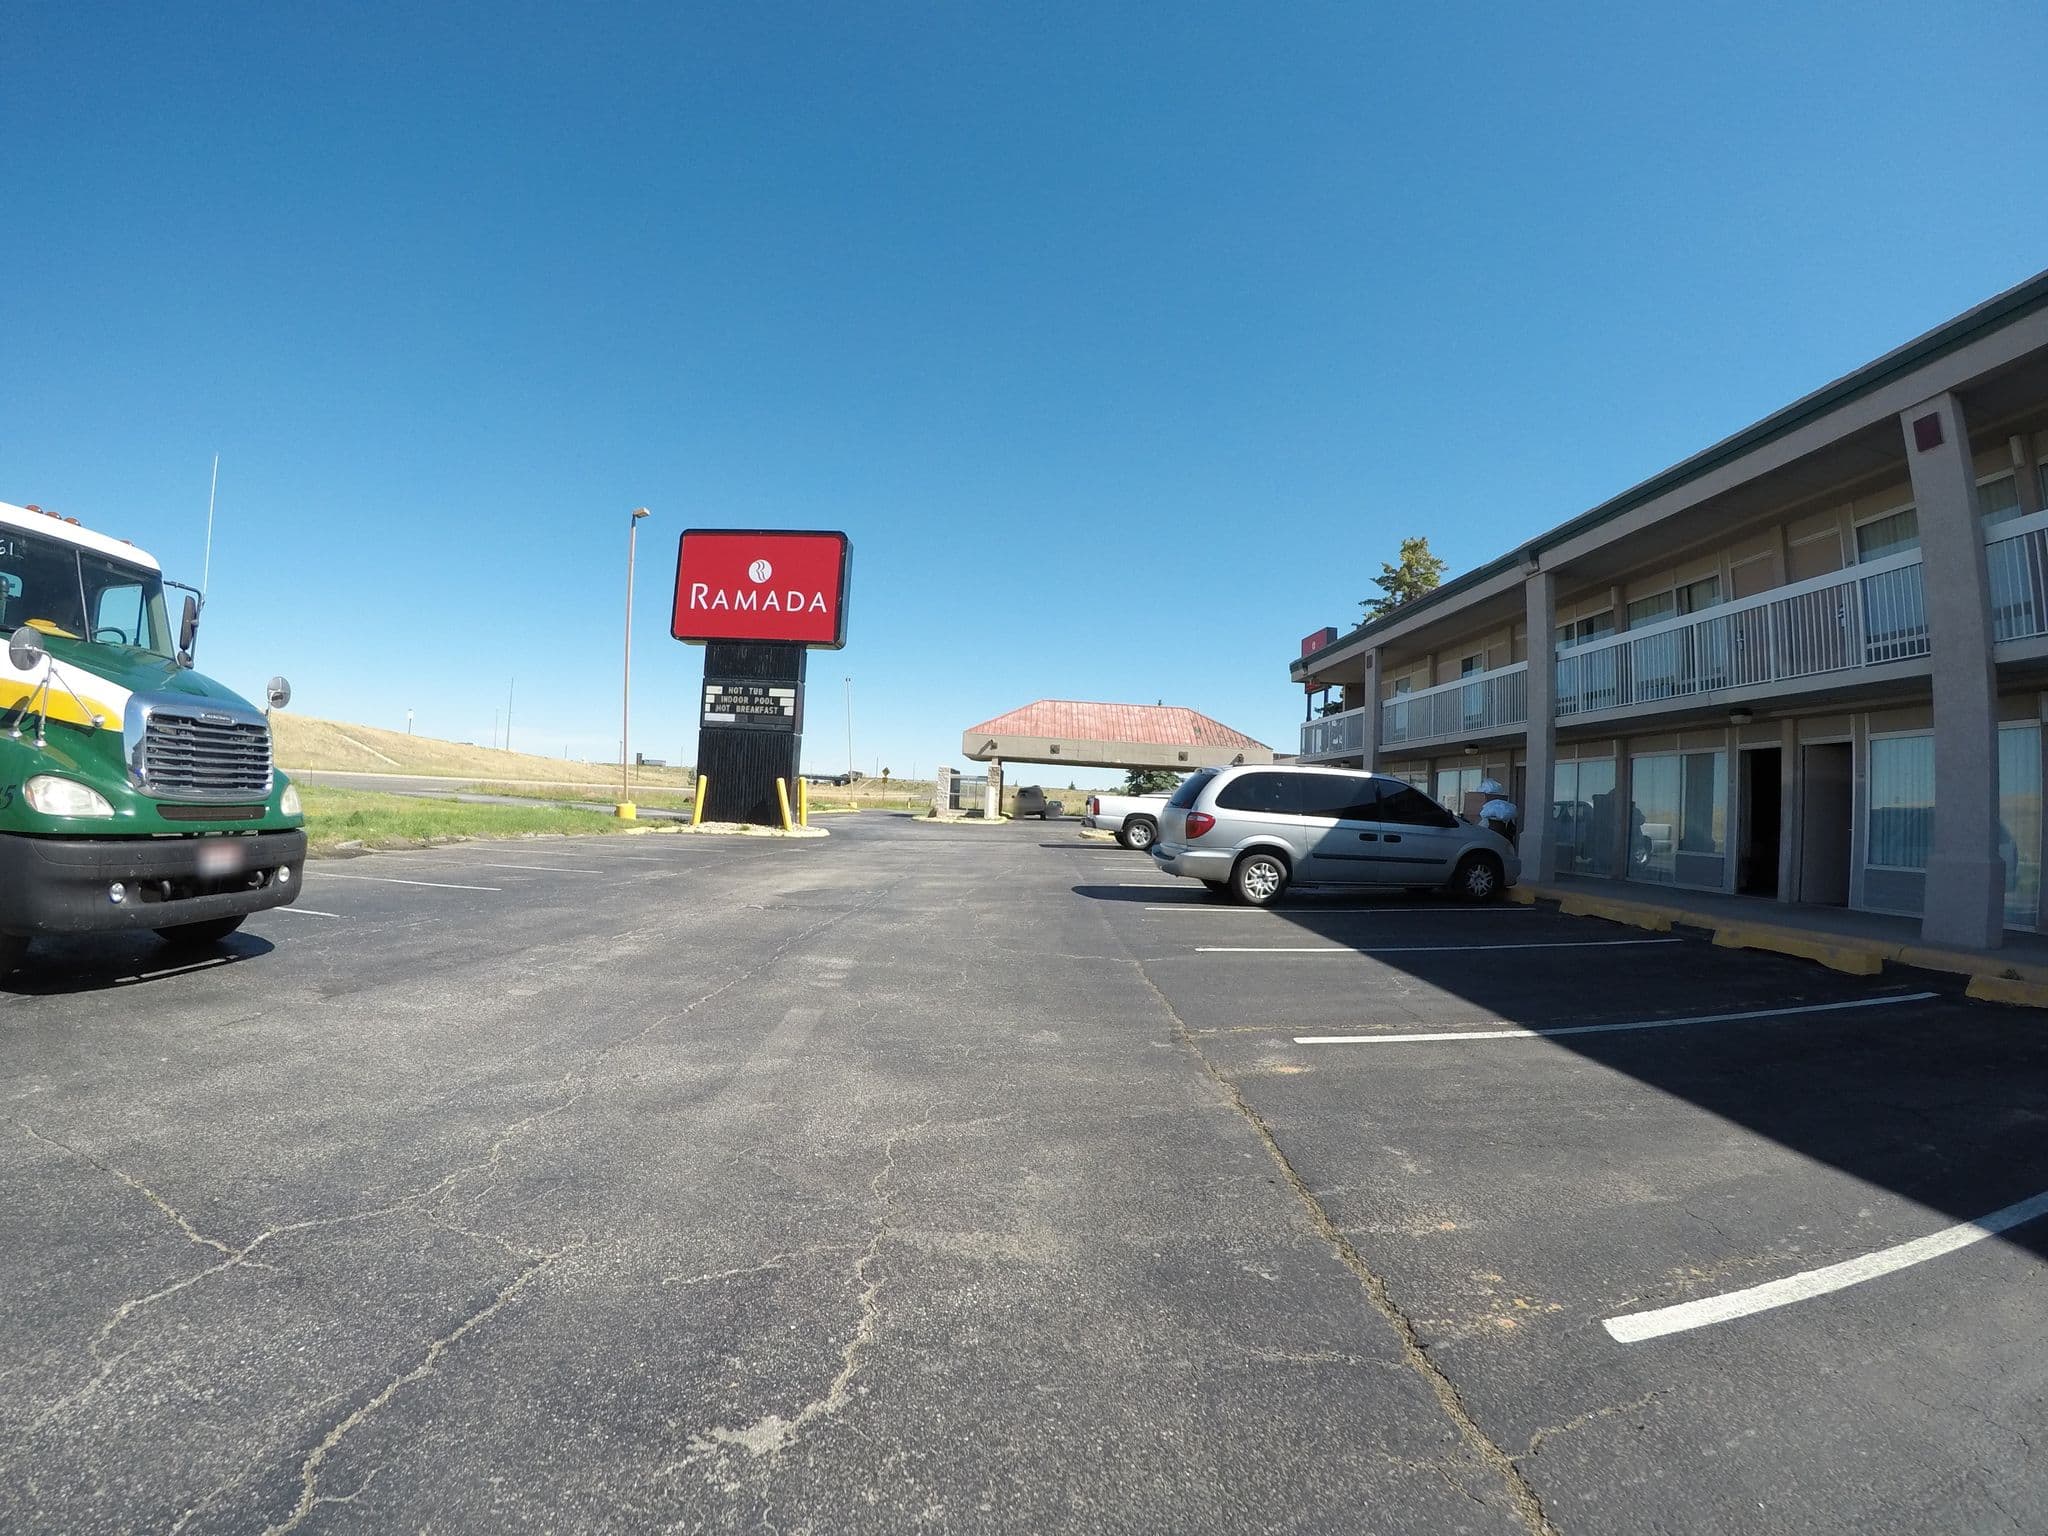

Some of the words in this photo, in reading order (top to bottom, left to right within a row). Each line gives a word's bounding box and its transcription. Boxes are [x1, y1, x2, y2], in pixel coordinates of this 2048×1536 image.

[749, 687, 763, 695] TUB
[721, 696, 749, 704] INDOOR
[754, 697, 774, 705] POOL
[736, 705, 778, 714] BREAKFAST
